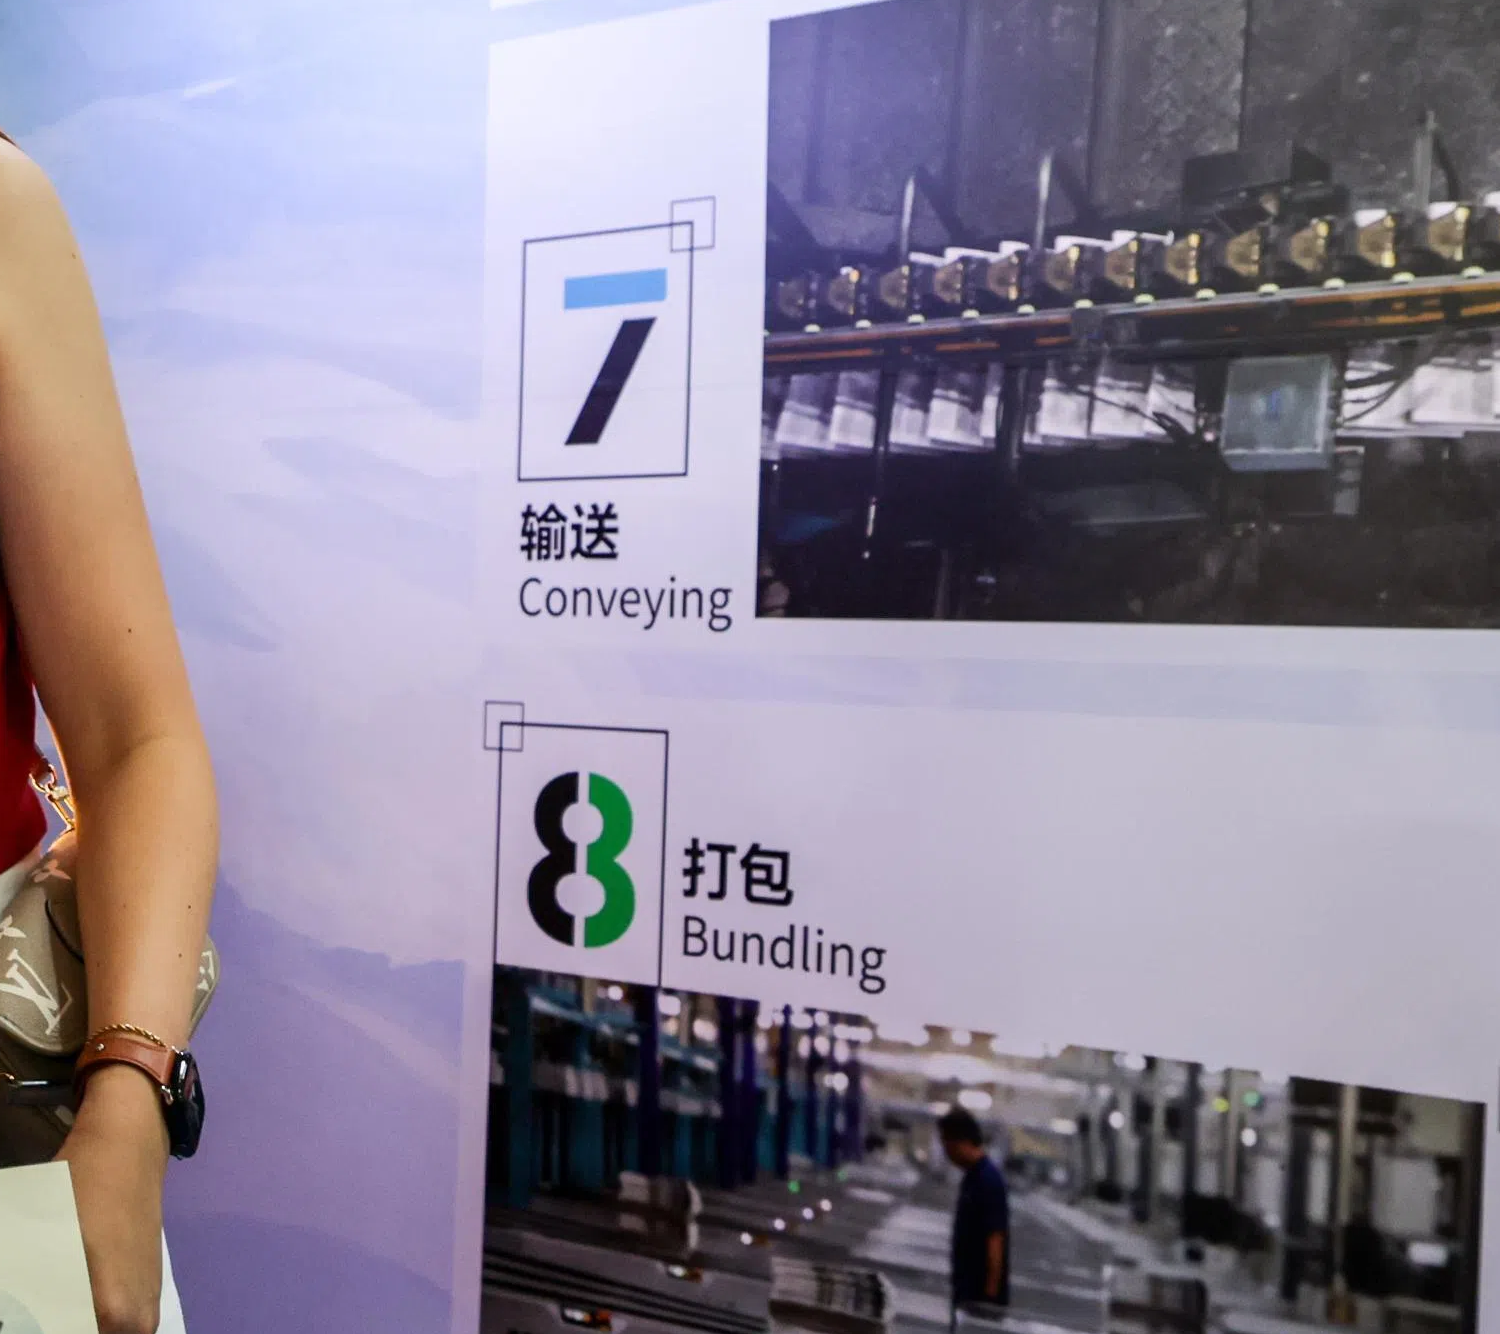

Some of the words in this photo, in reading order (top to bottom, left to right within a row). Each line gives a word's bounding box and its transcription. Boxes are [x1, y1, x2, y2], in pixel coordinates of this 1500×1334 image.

[563, 267, 667, 446] 7
[519, 503, 620, 562] 输送
[518, 578, 734, 633] Conveying
[526, 770, 636, 949] 8
[681, 837, 795, 907] 打包
[681, 916, 888, 995] Bundling
